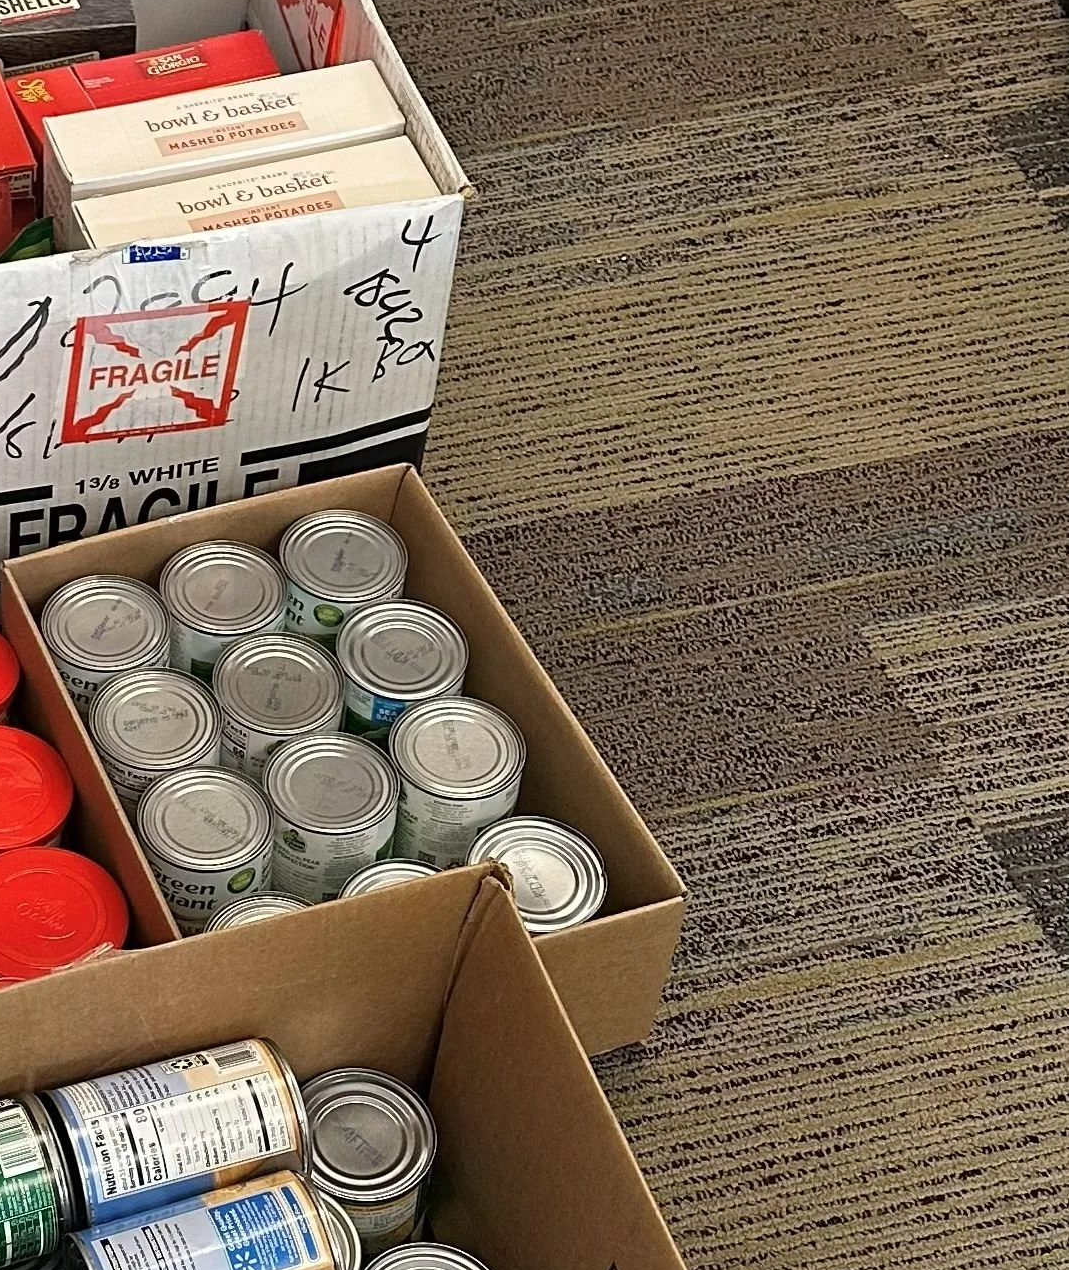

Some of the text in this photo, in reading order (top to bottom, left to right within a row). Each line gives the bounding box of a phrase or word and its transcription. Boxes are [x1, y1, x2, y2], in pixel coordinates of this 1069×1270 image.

[146, 56, 200, 77] GIORGIO
[145, 93, 297, 133] bowl & basket
[168, 119, 297, 151] MASHED POTATOES
[178, 172, 330, 215] bowl & basket
[263, 198, 333, 221] POTATOES
[89, 354, 219, 391] FRAGILE
[129, 457, 220, 486] WHITE
[91, 1119, 119, 1196] Nutrition Facts
